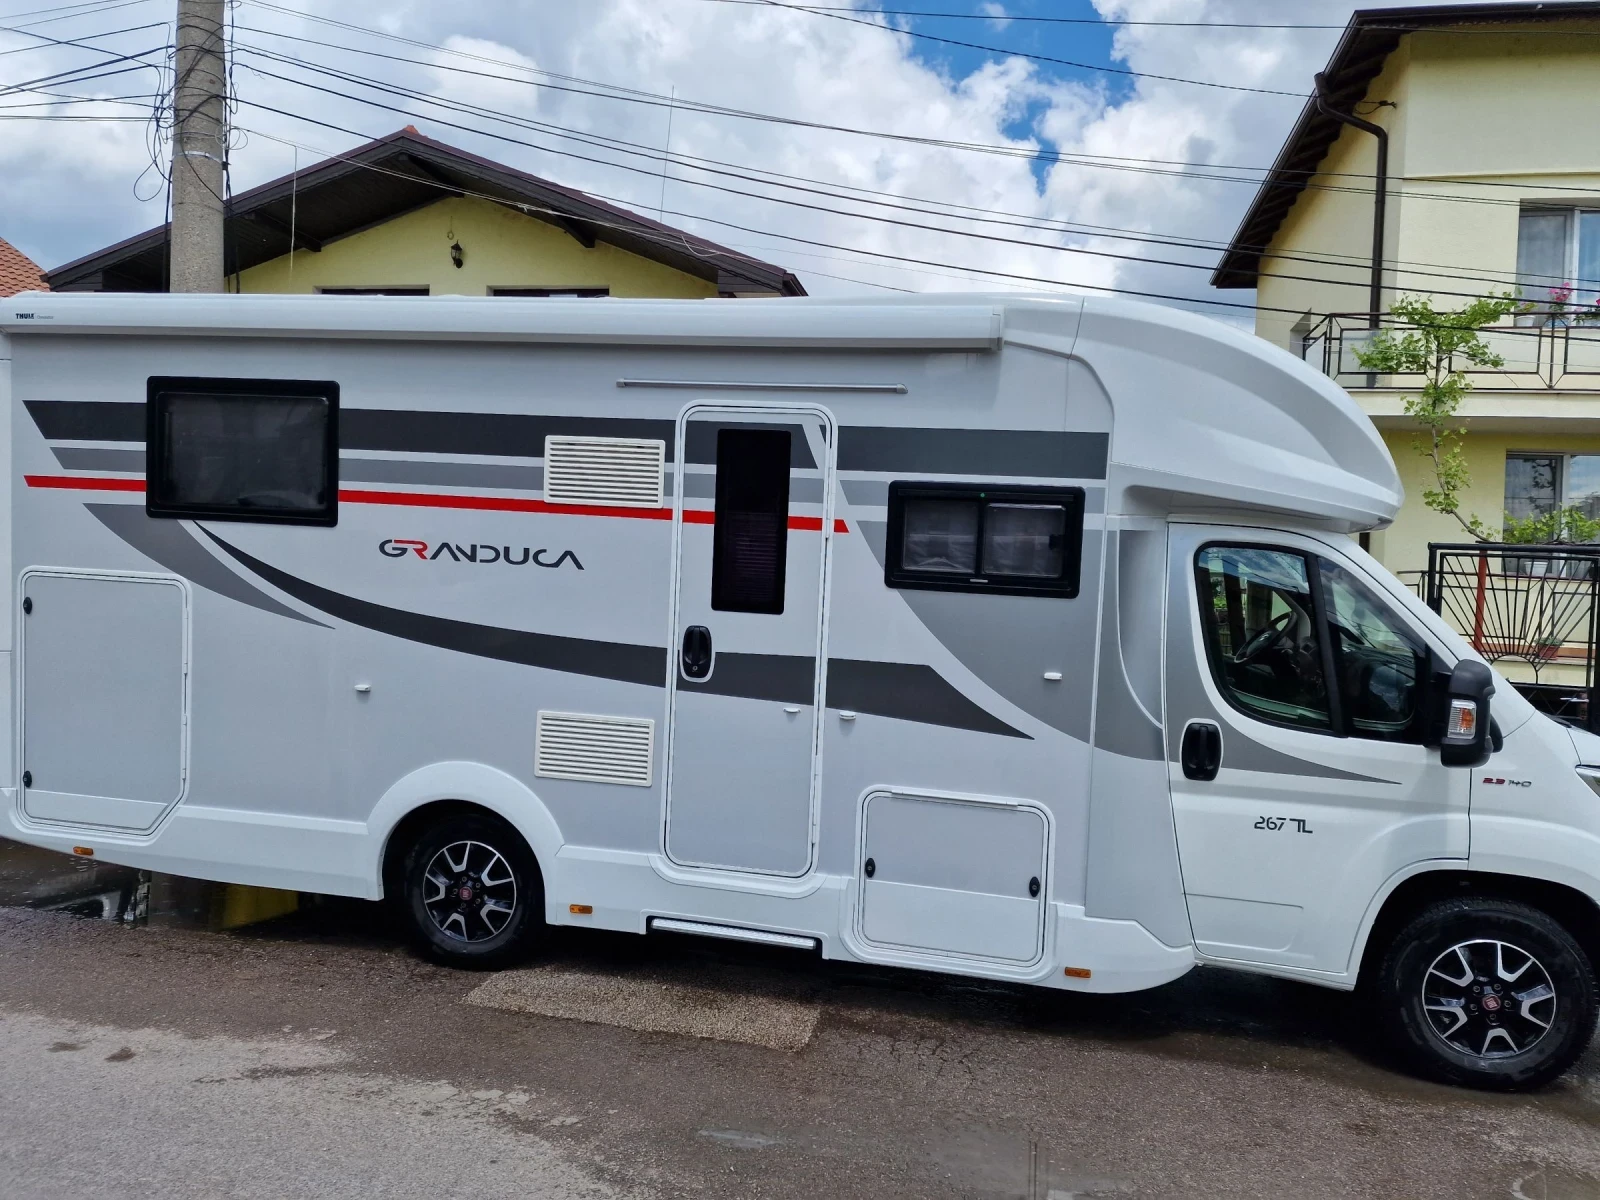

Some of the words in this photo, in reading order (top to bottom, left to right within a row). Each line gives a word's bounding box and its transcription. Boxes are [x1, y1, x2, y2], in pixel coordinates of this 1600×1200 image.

[378, 539, 585, 570] GRANDUCA
[1253, 815, 1287, 831] 267
[1289, 818, 1314, 834] TL
